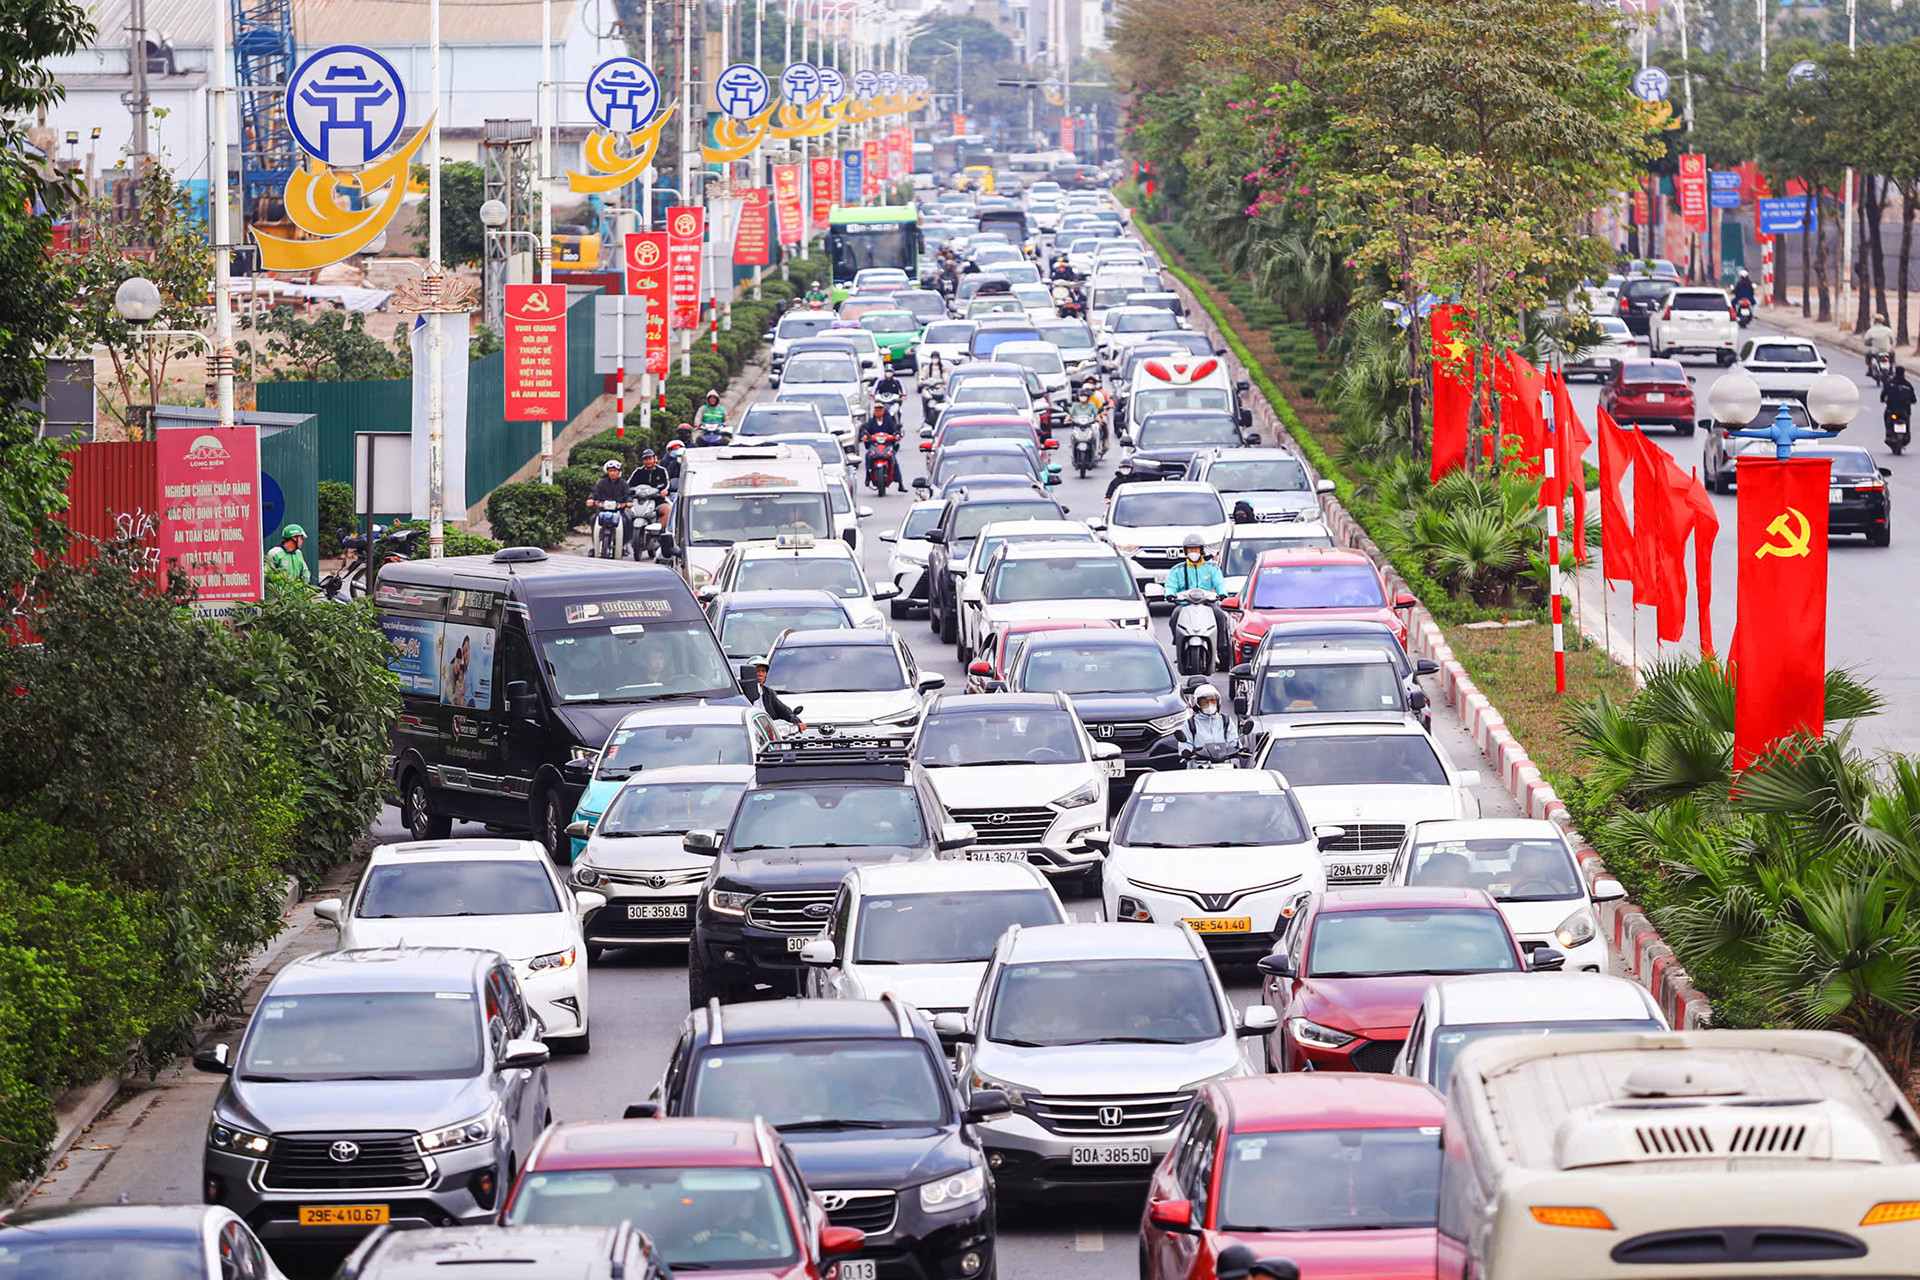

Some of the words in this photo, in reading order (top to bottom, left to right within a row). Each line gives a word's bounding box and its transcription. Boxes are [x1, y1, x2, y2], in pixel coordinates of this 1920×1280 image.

[520, 368, 534, 377] VIỆT
[165, 482, 191, 498] NGHIÊM
[193, 480, 212, 497] CHỈNH
[214, 479, 231, 496] CHẤP
[233, 480, 251, 495] HÀNH
[168, 505, 181, 520] CÁC
[183, 505, 195, 521] QUY
[197, 506, 213, 522] ĐỊNH
[224, 503, 239, 521] TRẬT
[241, 504, 250, 520] TỰ
[174, 530, 184, 543] AN
[186, 527, 202, 543] TOÀN
[203, 528, 220, 542] GIAO
[224, 551, 234, 567] THỊ
[222, 570, 250, 587] TRƯỜNG!
[601, 600, 645, 613] HOÀNG
[972, 851, 1026, 863] 34A-36242
[1333, 863, 1388, 877] 29A-677.88
[629, 905, 686, 918] 30E-358.49
[1074, 1147, 1149, 1163] 30A-385.50
[307, 1208, 381, 1223] 29E-410.67
